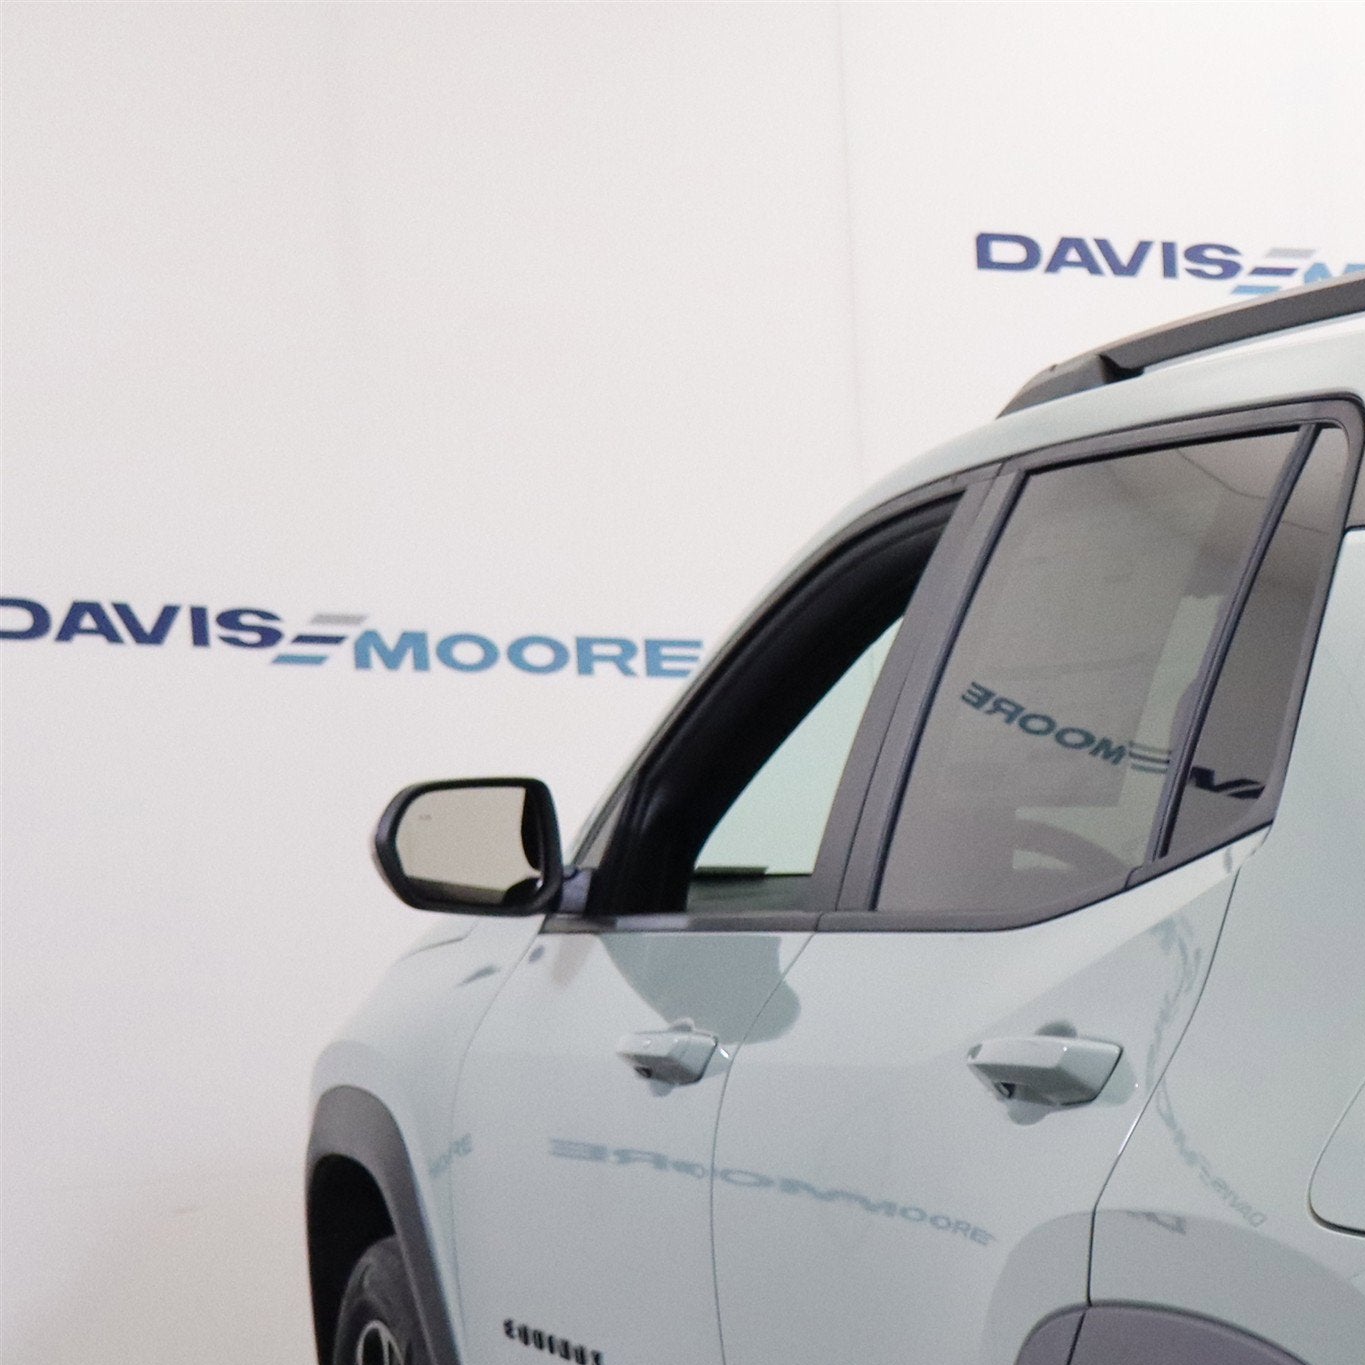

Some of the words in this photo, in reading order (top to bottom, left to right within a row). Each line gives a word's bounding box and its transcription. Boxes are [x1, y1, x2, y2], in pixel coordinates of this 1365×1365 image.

[974, 231, 1245, 281] DAVIS
[0, 596, 285, 649] DAVIS
[353, 628, 705, 679] MOORE
